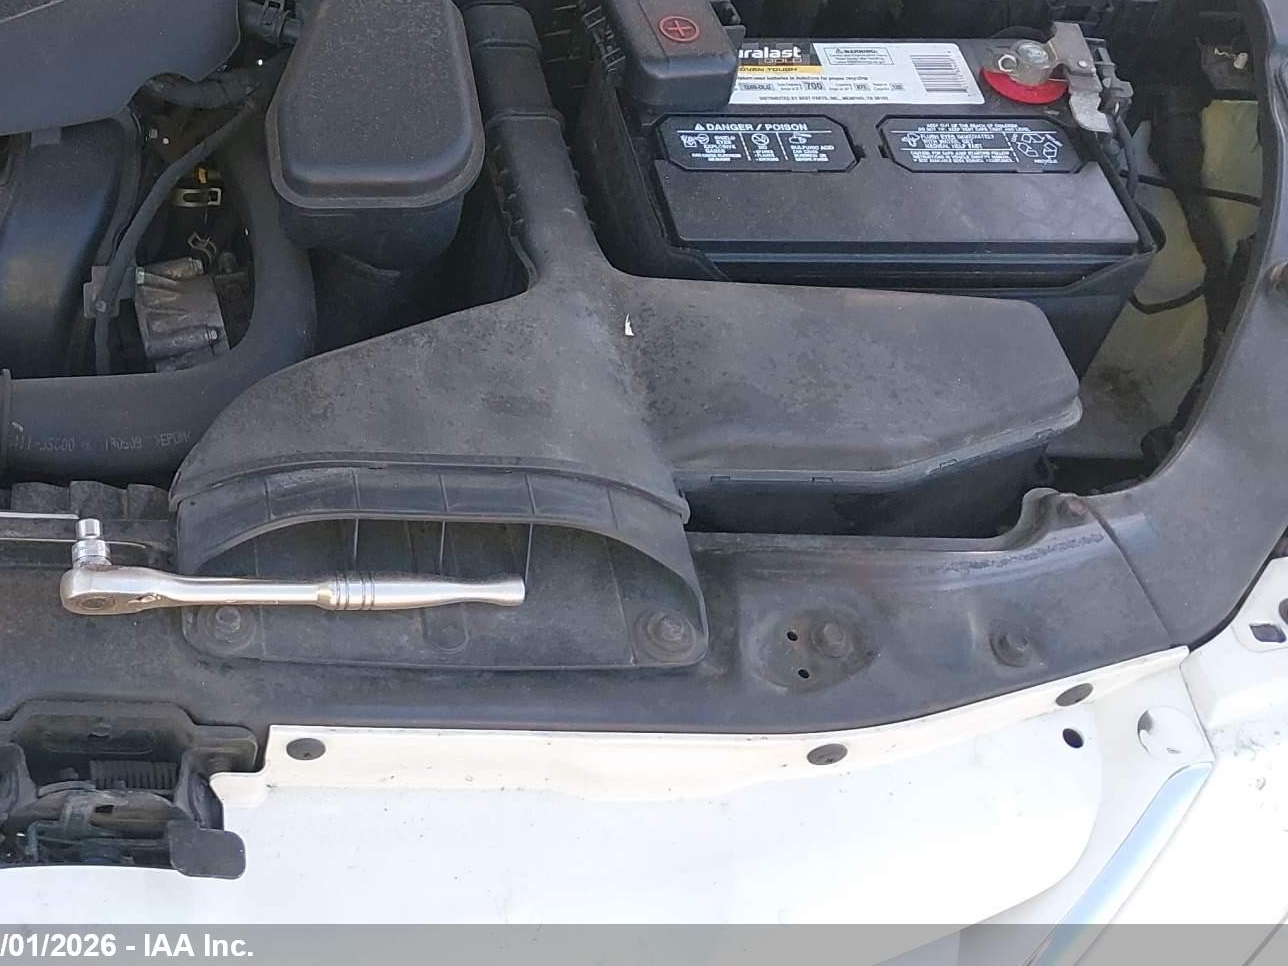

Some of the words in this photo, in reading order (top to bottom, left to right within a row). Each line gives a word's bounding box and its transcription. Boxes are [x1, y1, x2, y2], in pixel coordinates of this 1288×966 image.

[806, 82, 823, 90] 700
[706, 123, 754, 131] DANGER
[756, 123, 762, 131] /
[765, 123, 808, 131] POISON
